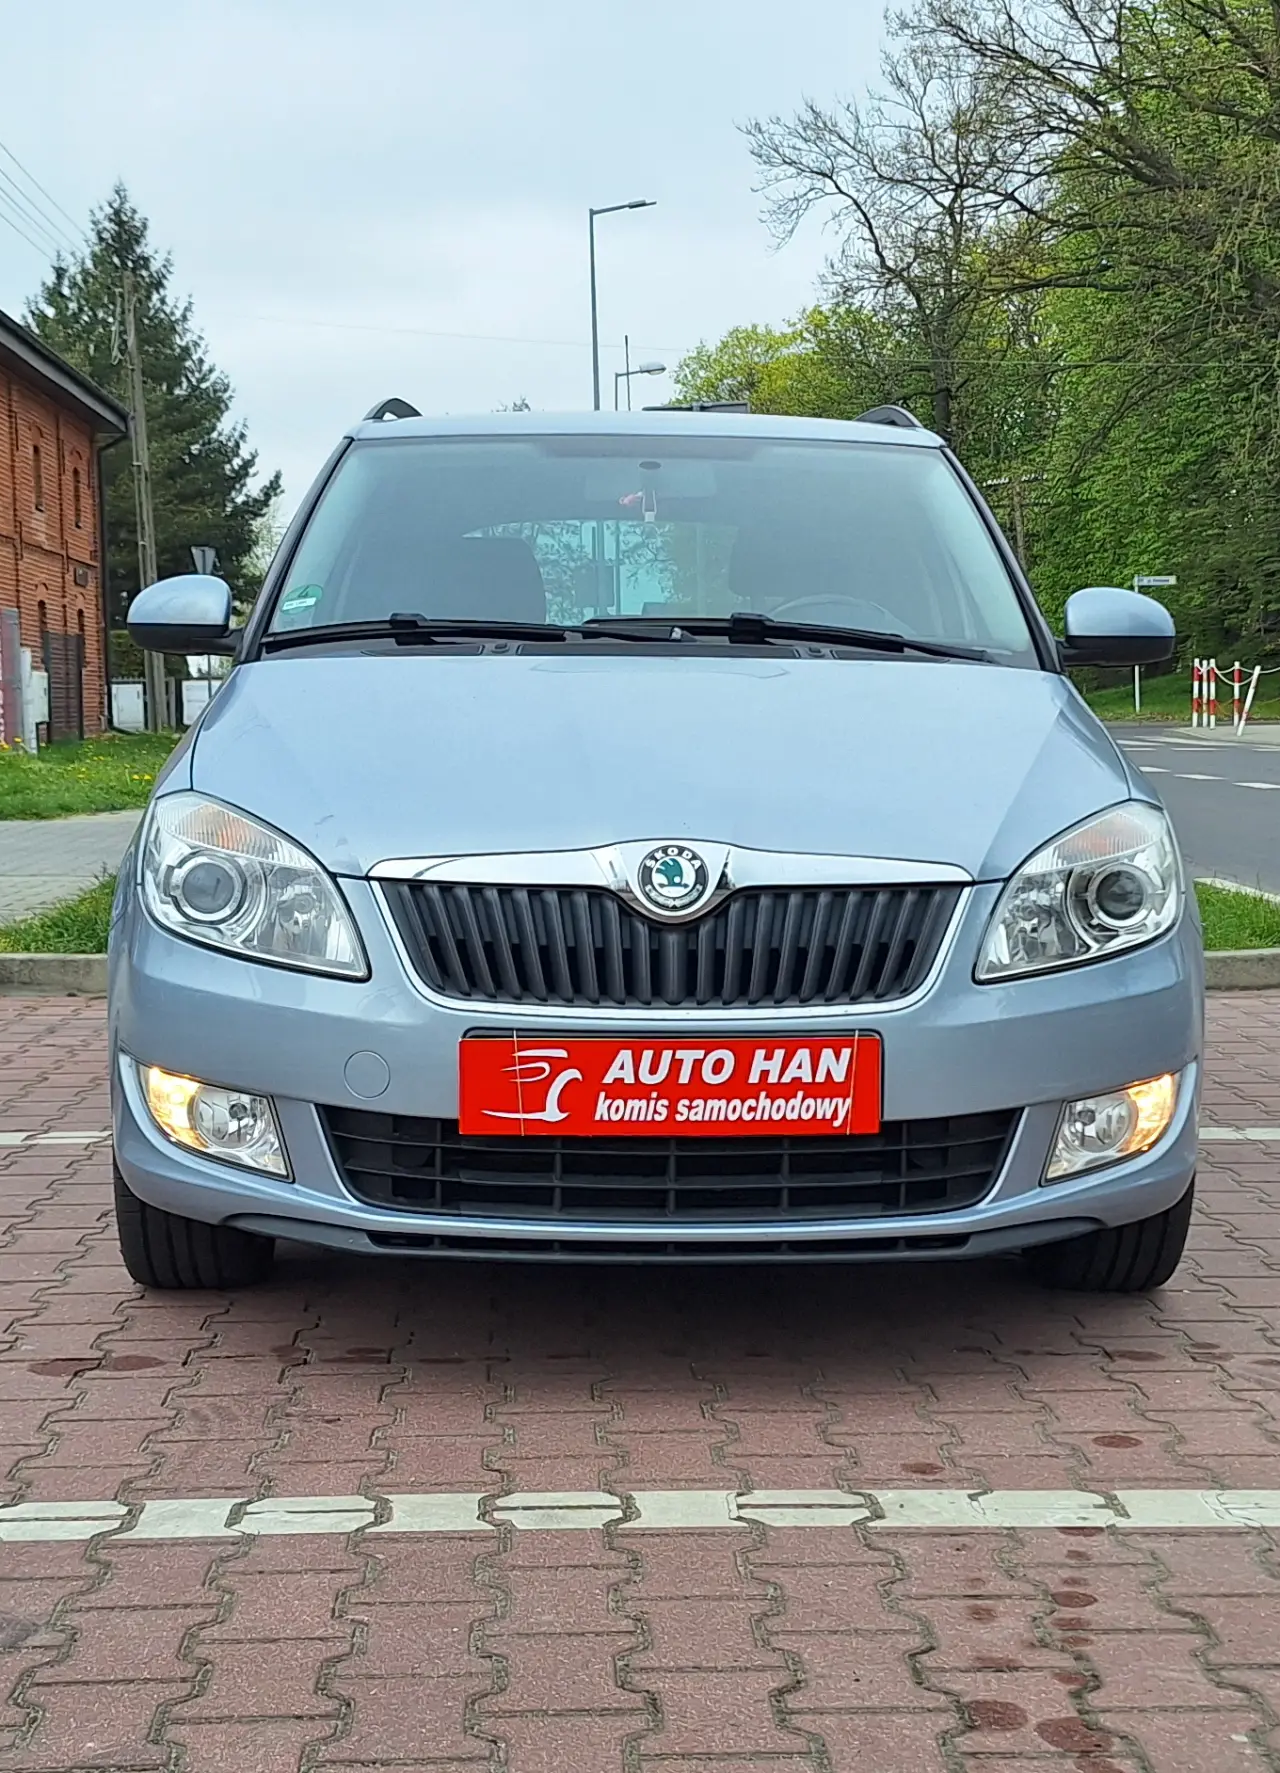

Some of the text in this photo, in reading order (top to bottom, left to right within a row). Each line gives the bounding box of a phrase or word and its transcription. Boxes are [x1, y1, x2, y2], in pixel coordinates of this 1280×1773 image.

[601, 1047, 854, 1085] AUTO HAN
[594, 1090, 851, 1128] komis samochodowy
